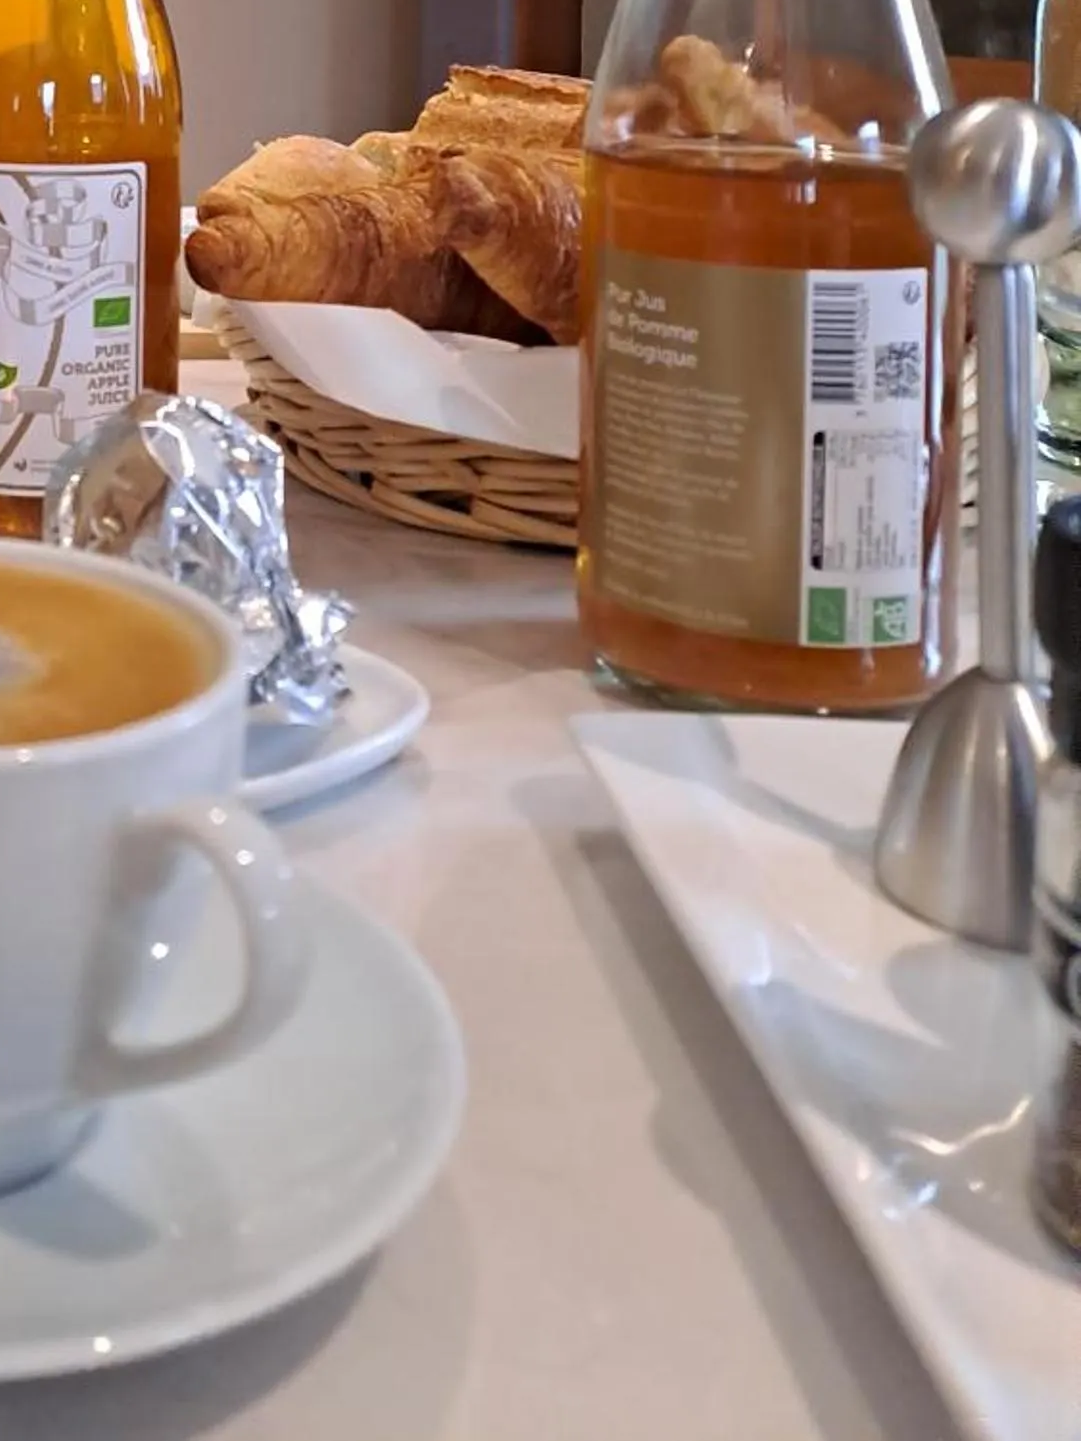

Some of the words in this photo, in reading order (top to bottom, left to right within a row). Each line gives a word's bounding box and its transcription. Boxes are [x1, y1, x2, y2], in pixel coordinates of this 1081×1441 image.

[633, 289, 666, 313] Jus
[95, 343, 130, 359] PURE
[61, 358, 130, 376] ORGANIC
[87, 374, 129, 391] APPLE
[87, 388, 129, 407] JUICE
